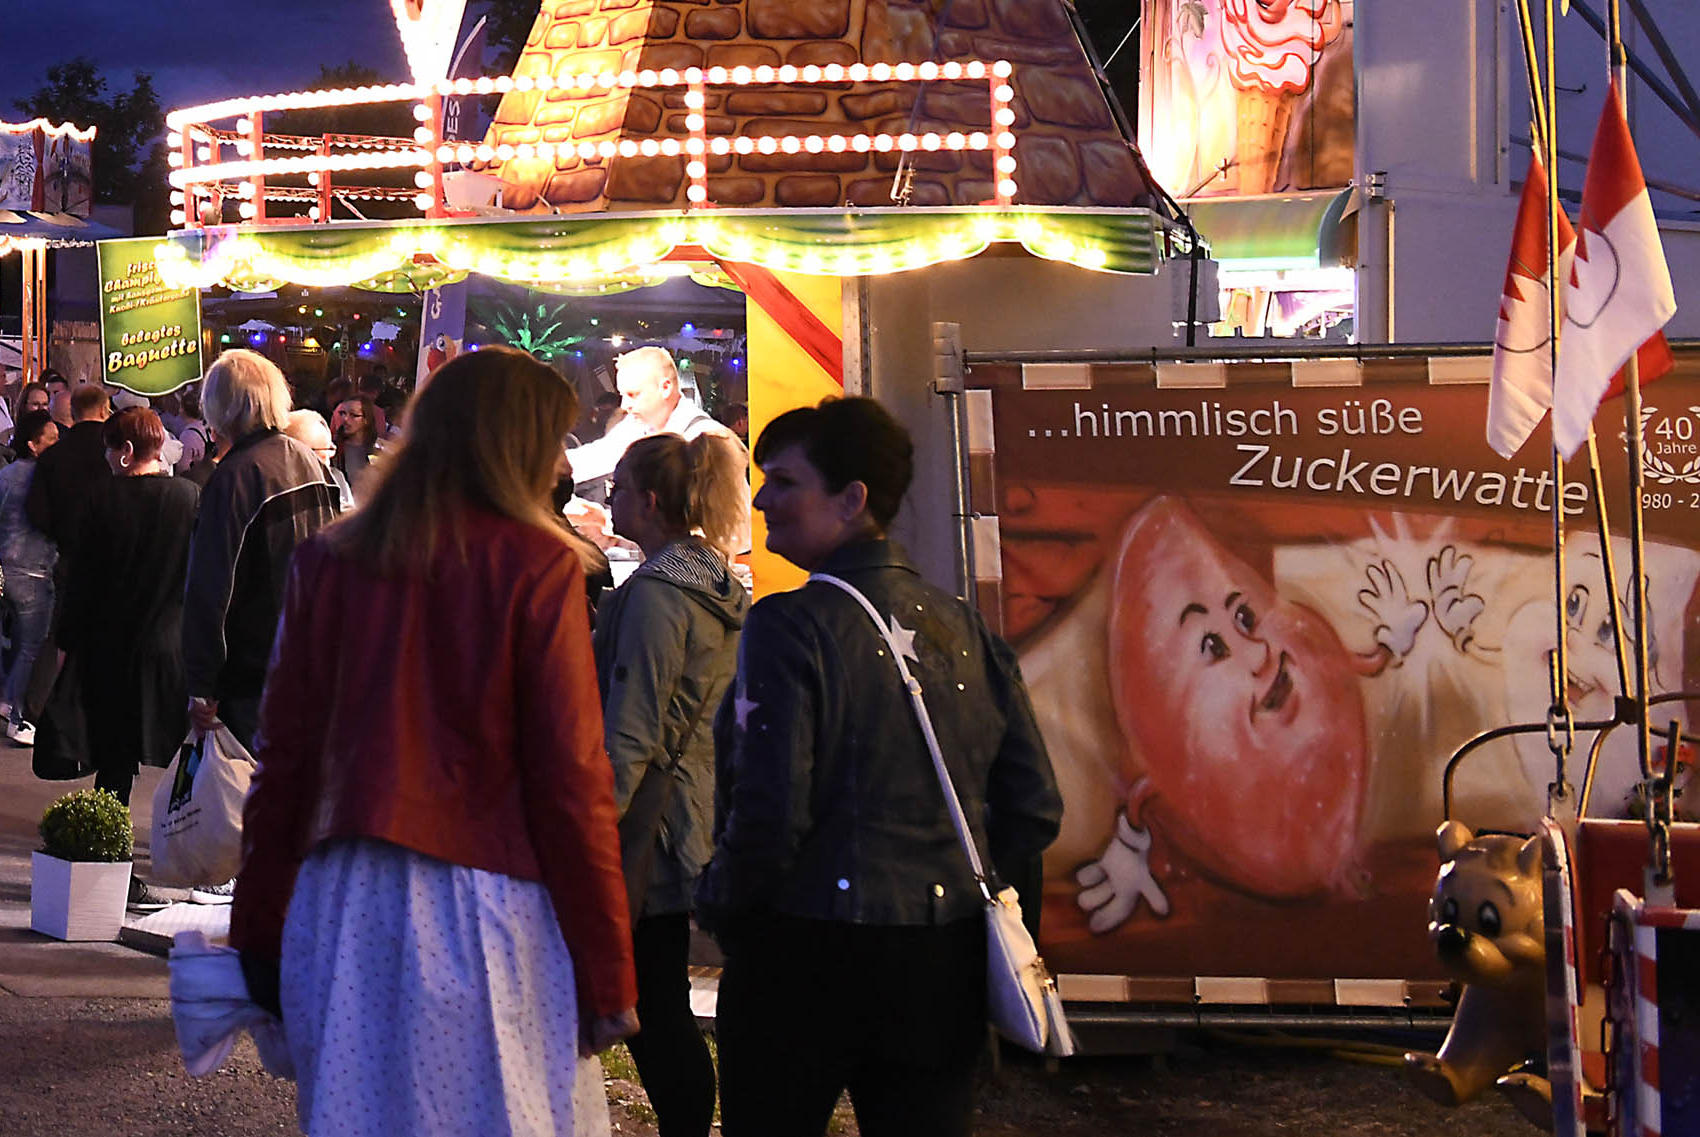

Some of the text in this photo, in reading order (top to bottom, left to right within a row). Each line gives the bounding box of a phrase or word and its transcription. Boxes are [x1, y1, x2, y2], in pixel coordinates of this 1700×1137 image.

[121, 325, 182, 346] belegtes
[108, 338, 197, 373] Baguette
[1029, 399, 1423, 437] ...himmlisch süße
[1655, 416, 1693, 440] 40
[1657, 442, 1697, 454] Jahre
[1229, 445, 1589, 515] Zuckerwatte
[1642, 493, 1672, 509] 980
